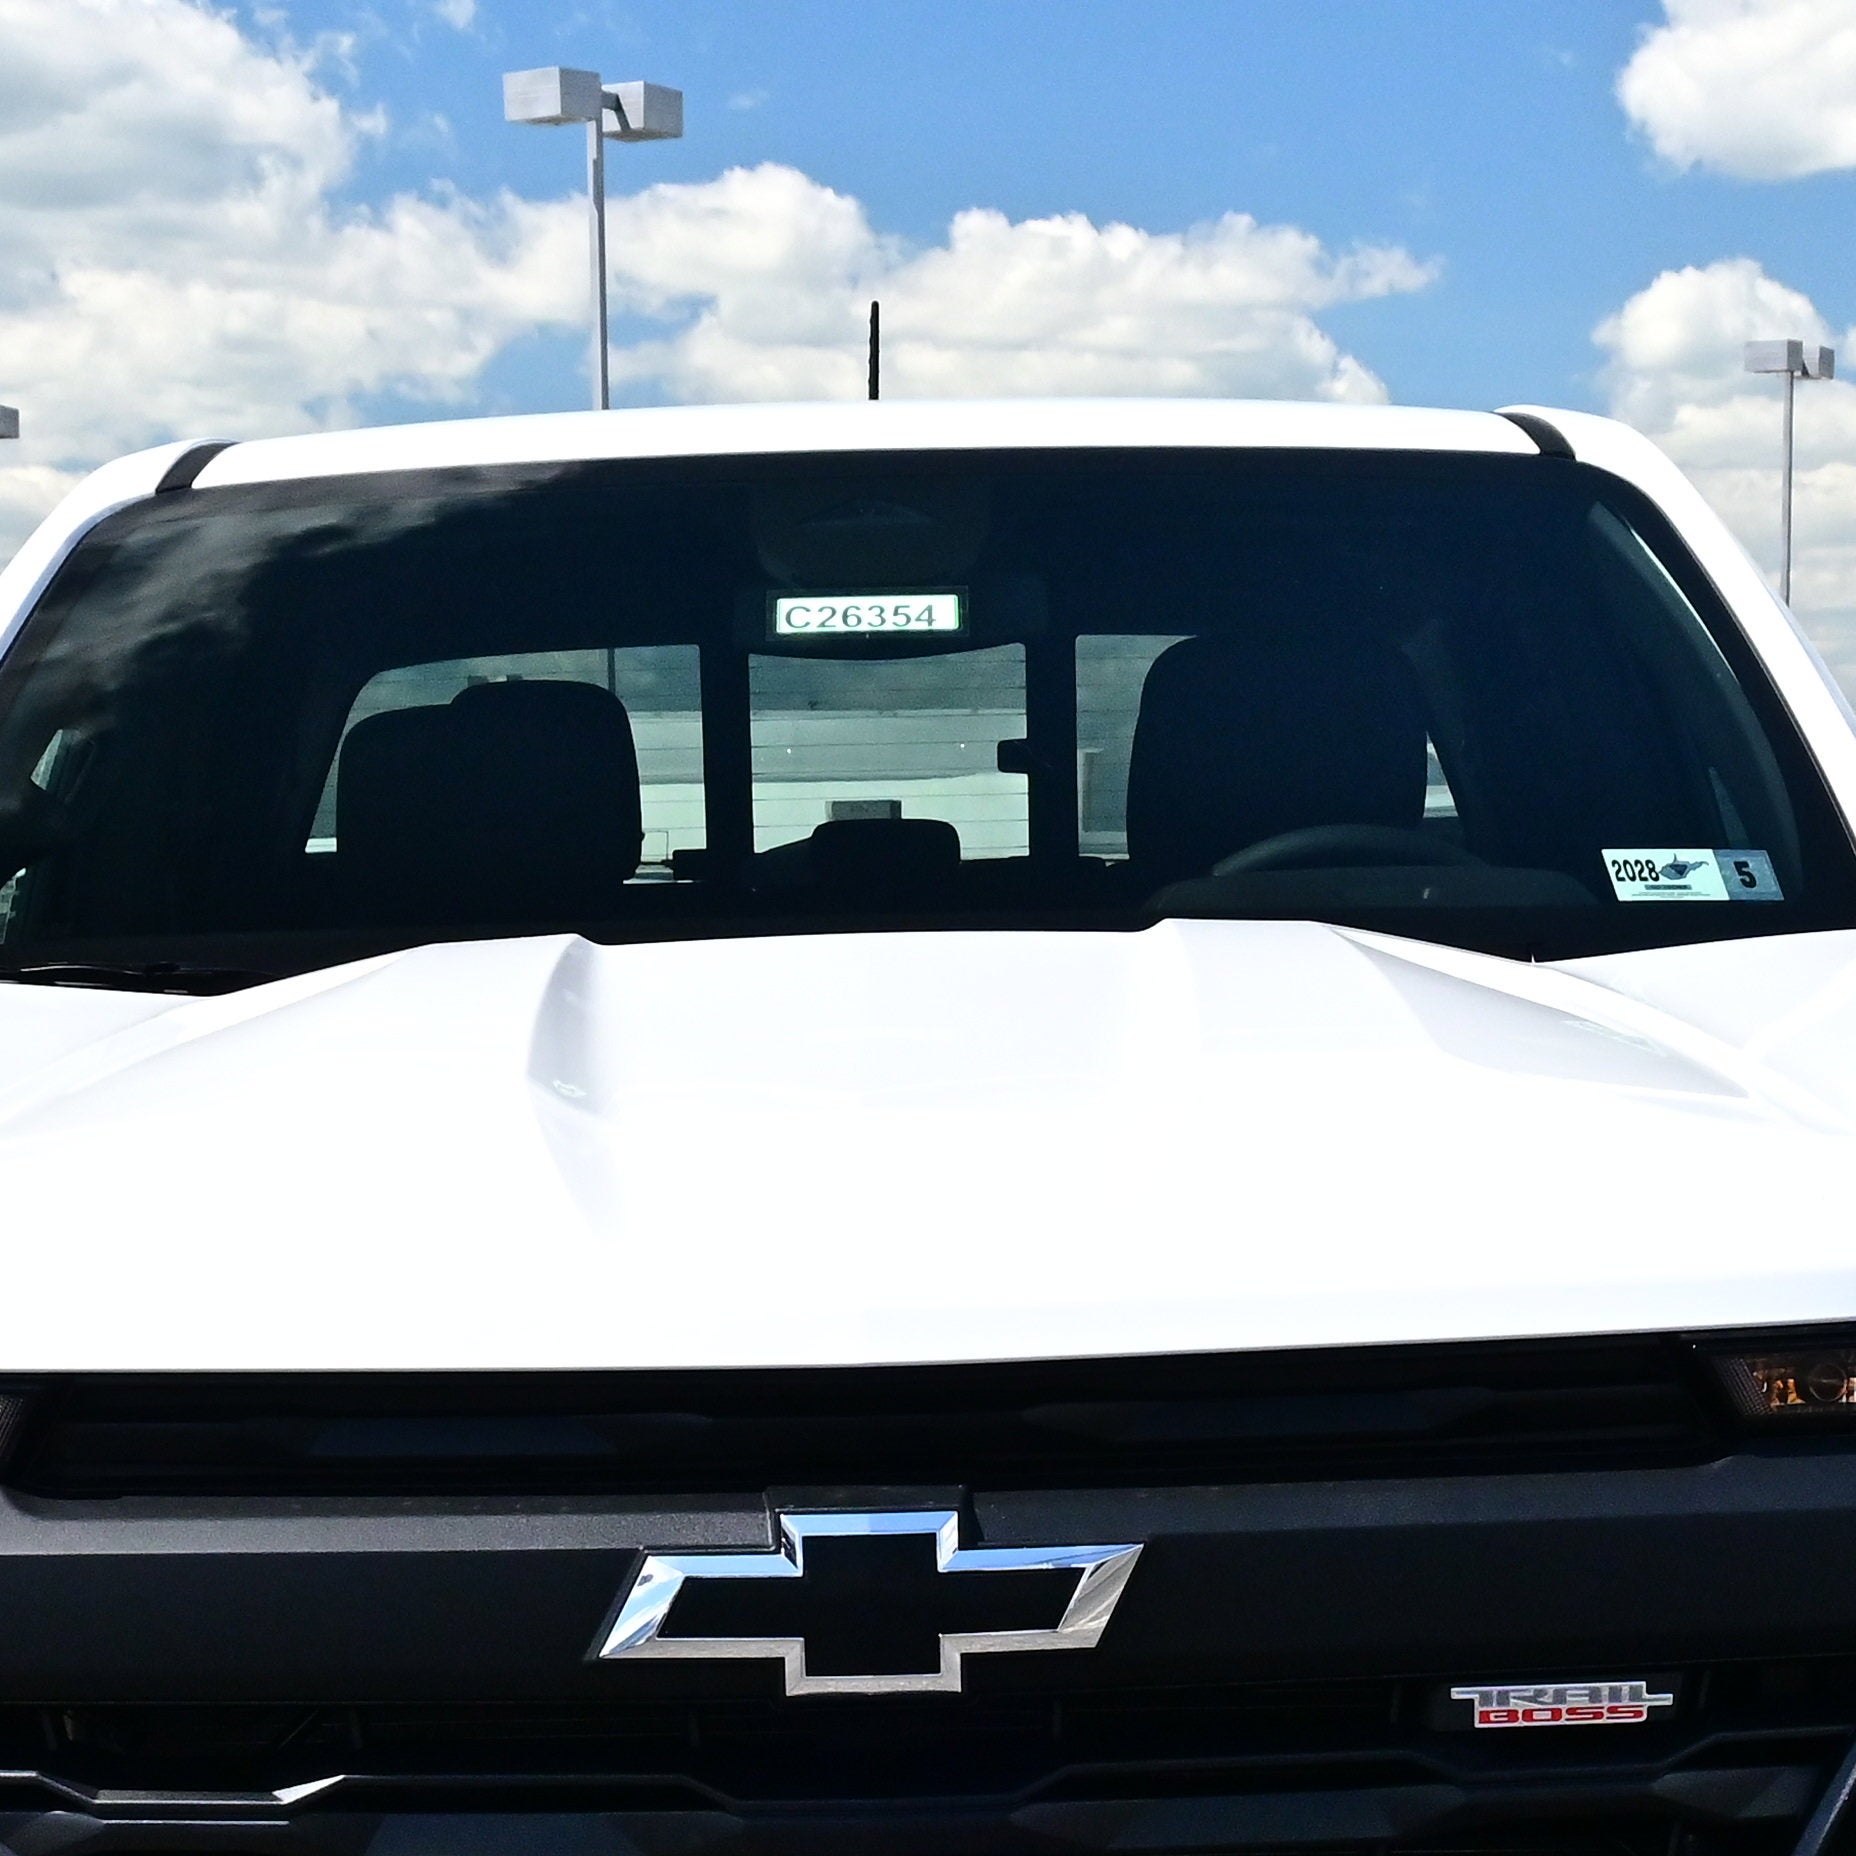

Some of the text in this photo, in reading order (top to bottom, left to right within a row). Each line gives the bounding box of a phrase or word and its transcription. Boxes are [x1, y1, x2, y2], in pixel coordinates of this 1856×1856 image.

[785, 604, 936, 628] C26354
[1611, 859, 1660, 882] 2028
[1733, 861, 1757, 888] 5
[1451, 1683, 1674, 1708] TRAIL
[1478, 1704, 1645, 1725] BOSS
